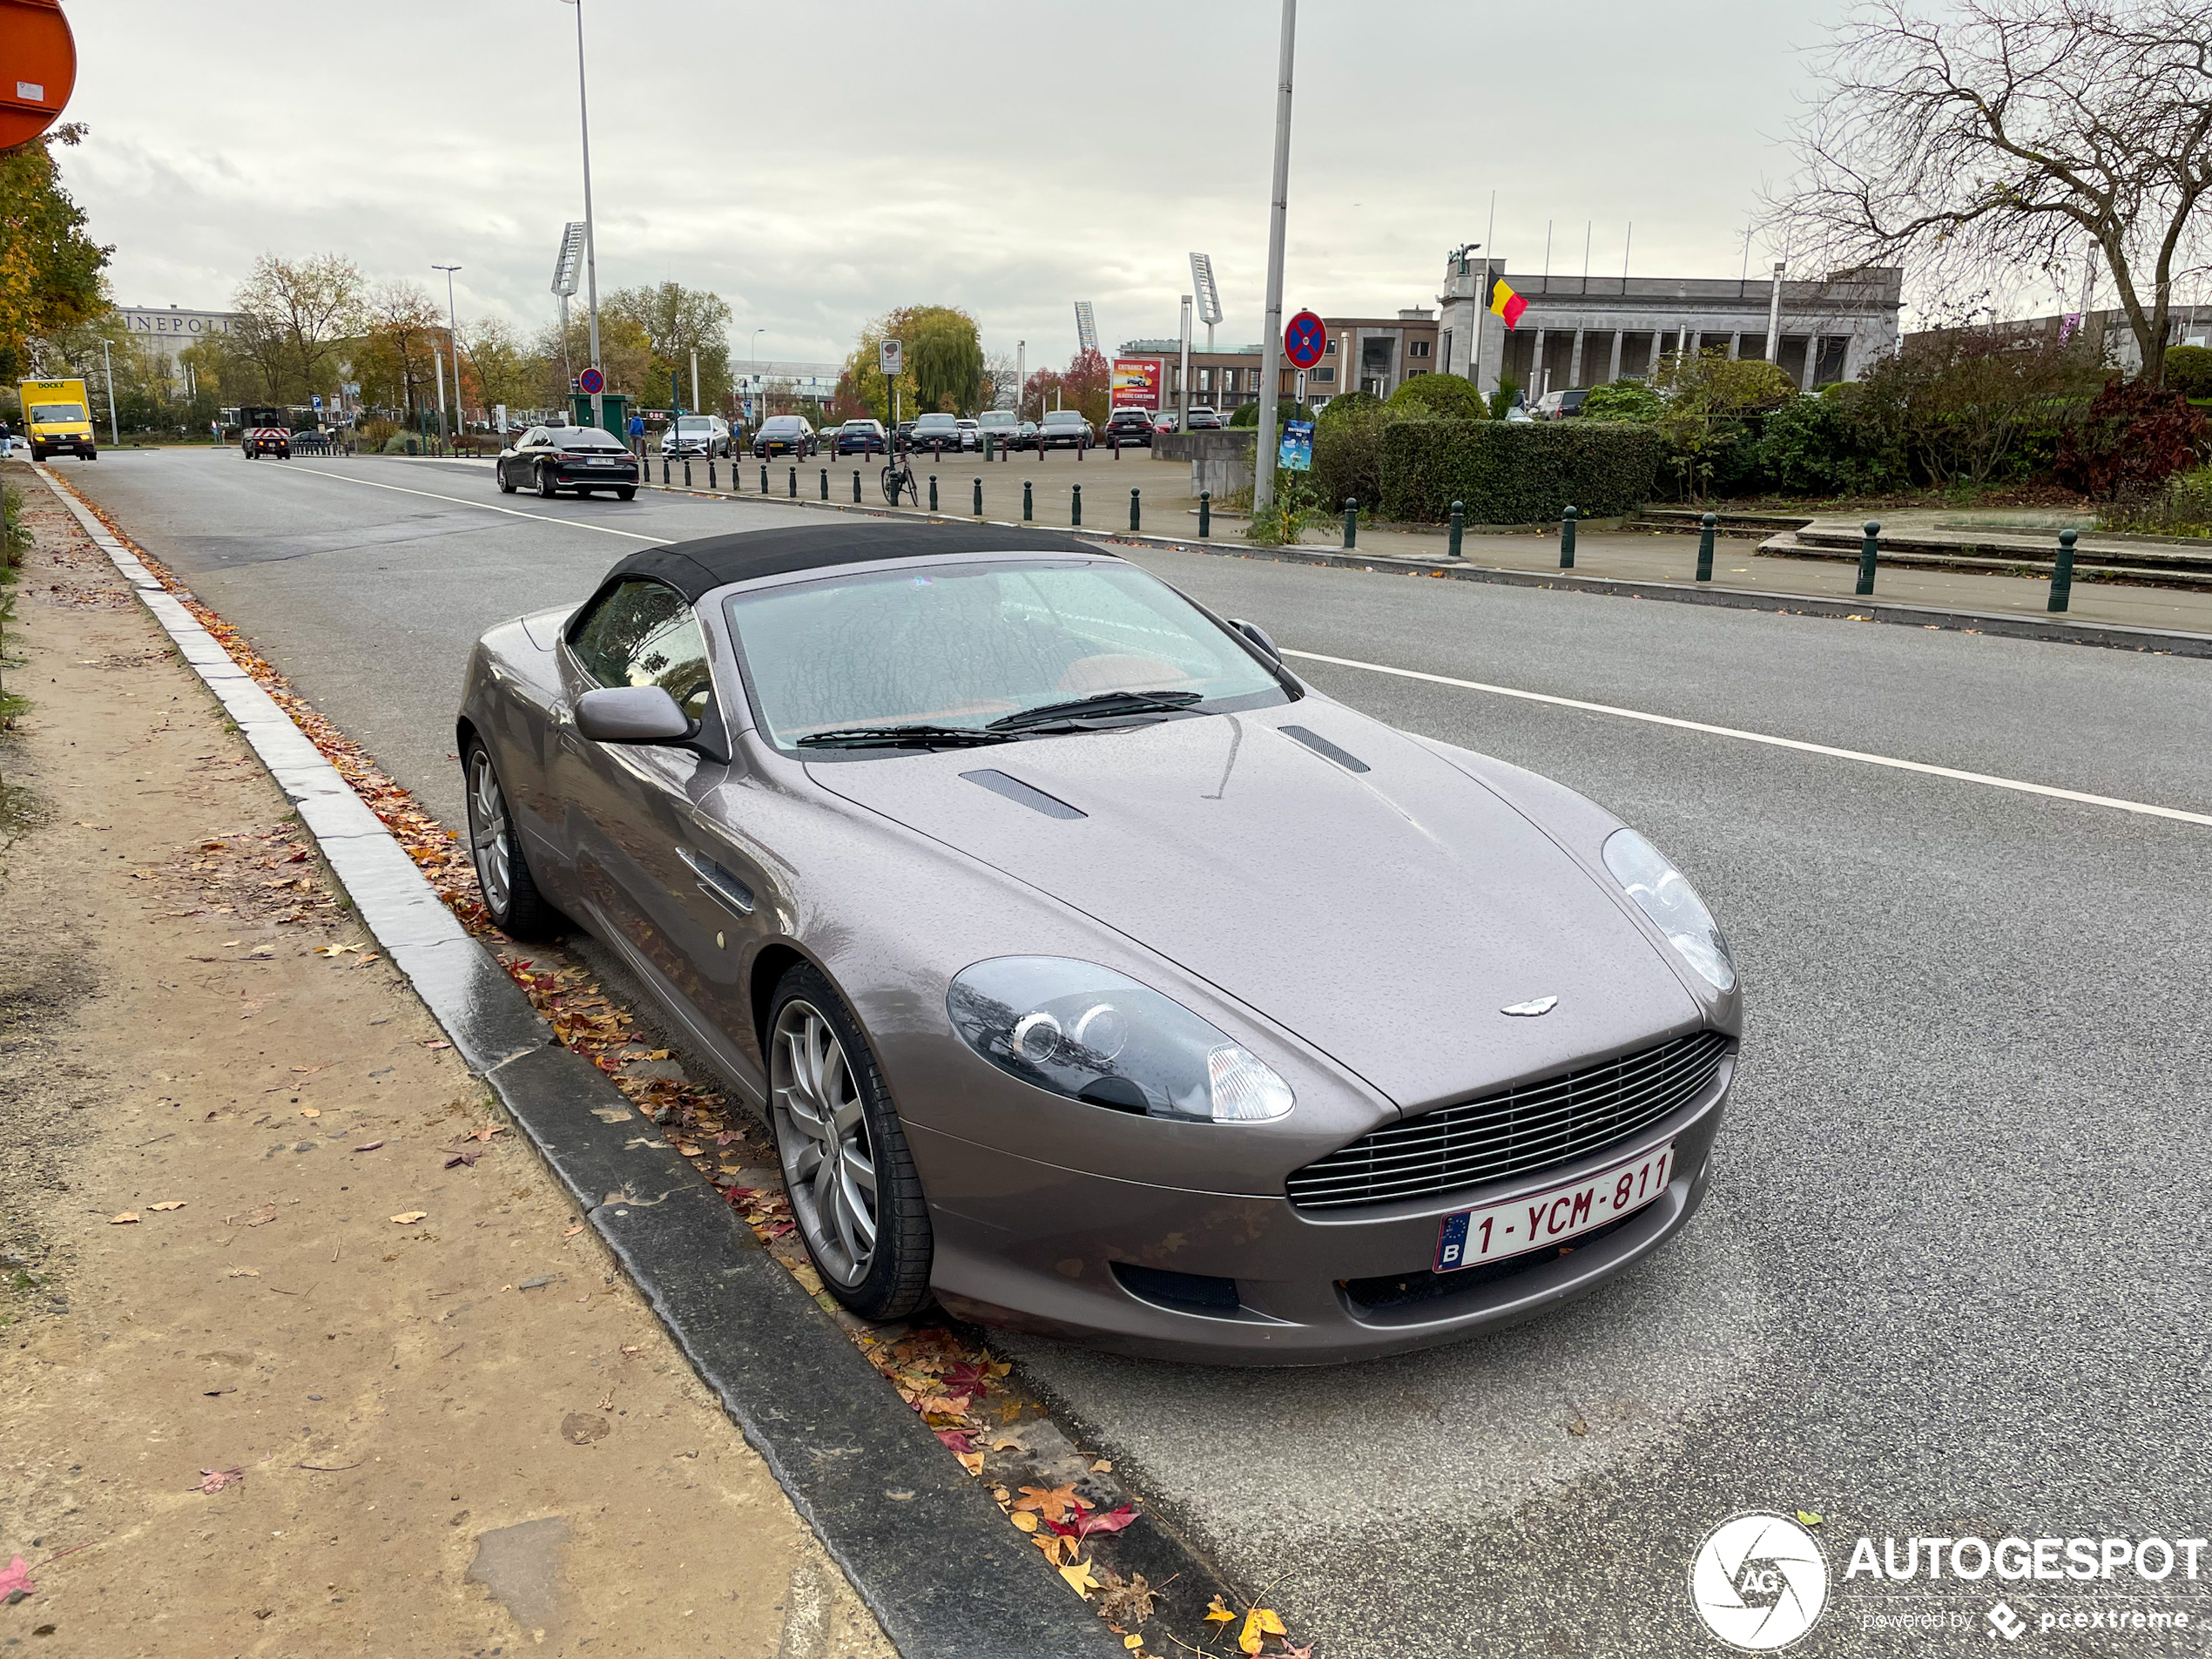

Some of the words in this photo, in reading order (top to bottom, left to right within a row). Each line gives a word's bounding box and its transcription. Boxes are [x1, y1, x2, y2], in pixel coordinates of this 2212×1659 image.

[314, 396, 320, 406] P
[1479, 1153, 1667, 1253] 1-YCM-811
[1443, 1244, 1460, 1263] B
